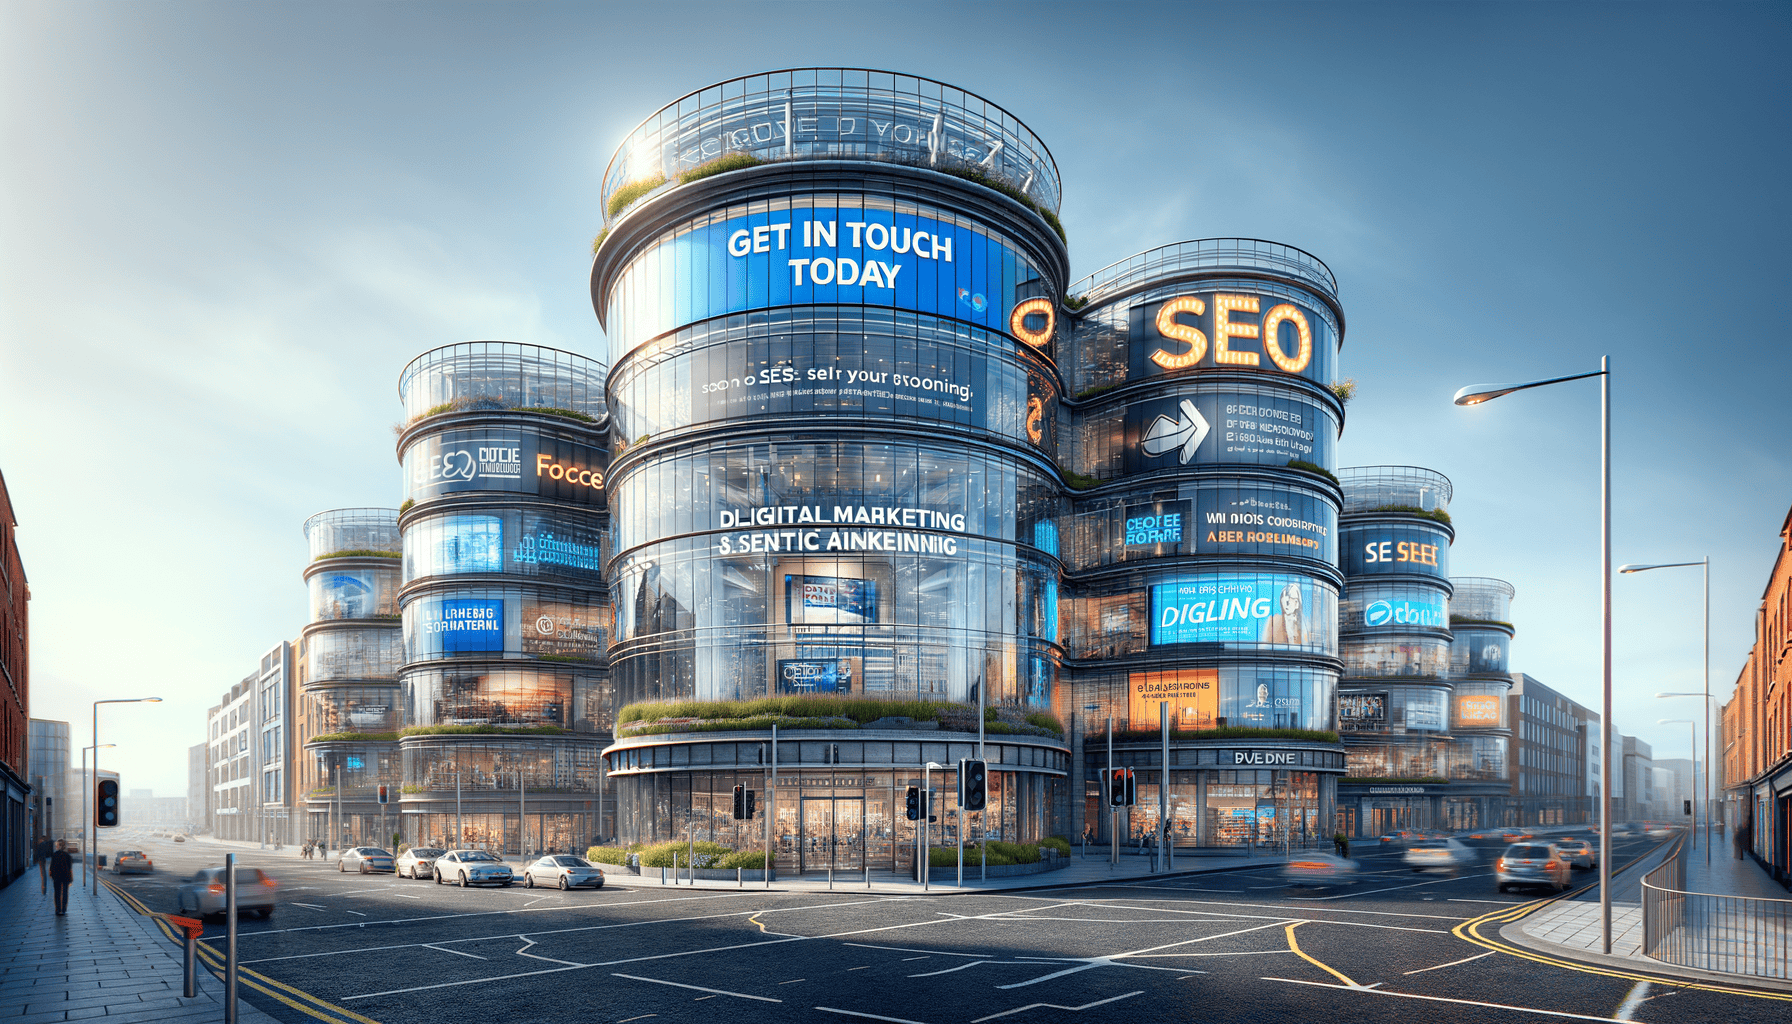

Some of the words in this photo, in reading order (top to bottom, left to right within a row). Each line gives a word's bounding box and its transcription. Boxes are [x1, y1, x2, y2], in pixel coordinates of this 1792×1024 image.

[727, 222, 791, 258] GET
[804, 219, 837, 248] IN
[845, 220, 952, 263] TOUCH
[788, 257, 902, 290] TODAY
[1149, 293, 1313, 374] SEO
[846, 369, 889, 384] your
[833, 505, 966, 532] MARKETING
[1365, 541, 1393, 563] SE
[1159, 597, 1273, 628] DIGLING
